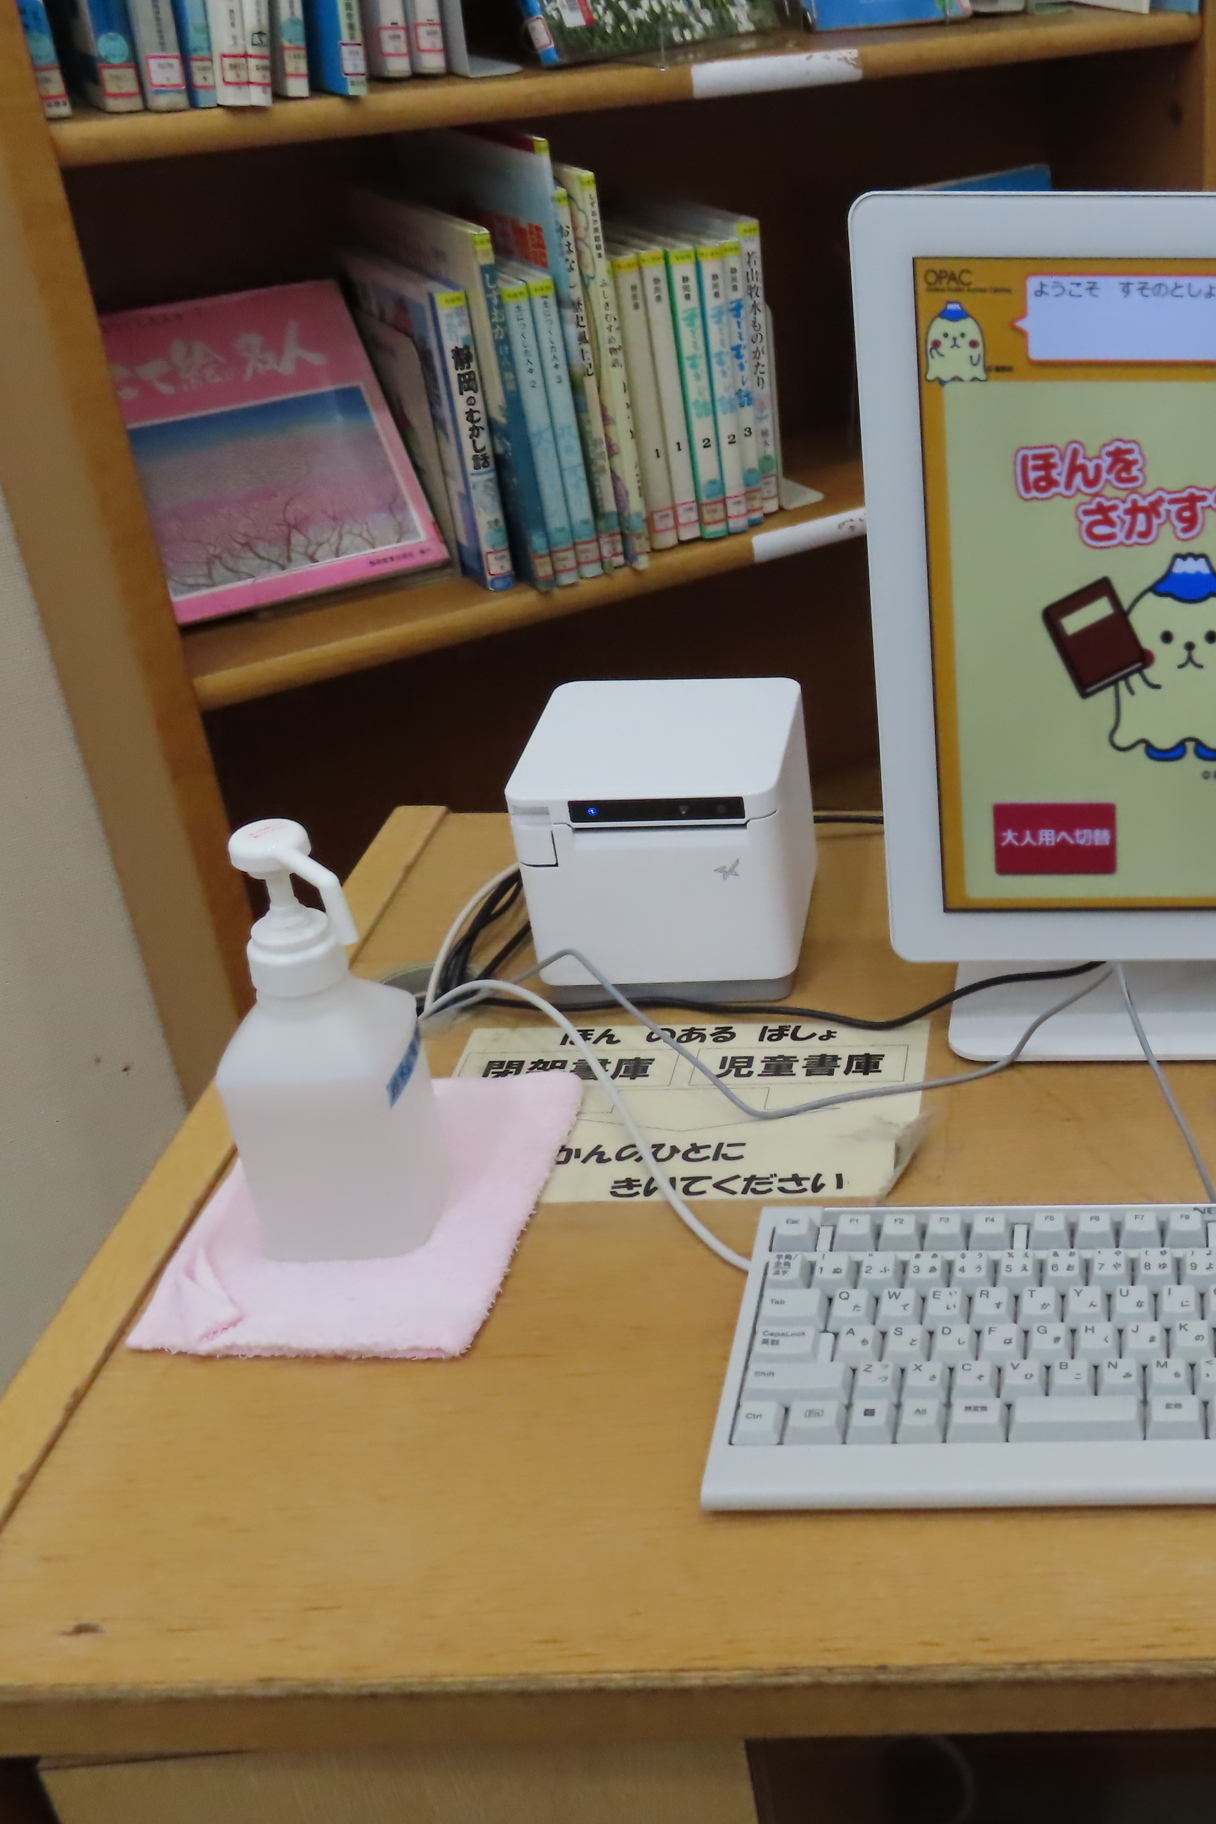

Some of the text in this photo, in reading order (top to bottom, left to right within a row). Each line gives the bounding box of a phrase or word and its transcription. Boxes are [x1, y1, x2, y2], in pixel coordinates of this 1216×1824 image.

[924, 269, 972, 287] OPAC
[1034, 281, 1101, 298] ようこそ
[451, 344, 491, 471] 静岡のむかし話
[743, 427, 753, 437] 3
[702, 438, 712, 448] 2
[727, 434, 737, 445] 2
[675, 442, 682, 451] 1
[655, 449, 661, 459] 1
[1017, 441, 1143, 498] ほんを
[1001, 829, 1111, 846] 大人用へ切替
[646, 1025, 737, 1044] のある
[758, 1025, 838, 1042] ばしょ
[718, 1053, 886, 1078] 児童書庫
[609, 1173, 844, 1198] きいてください
[913, 1265, 920, 1273] 3
[1144, 1262, 1151, 1270] 8
[1190, 1262, 1197, 1270] 9
[839, 1291, 849, 1300] Q
[888, 1291, 901, 1300] W
[933, 1291, 941, 1299] E
[980, 1290, 989, 1298] R
[1029, 1290, 1036, 1298] T
[1074, 1289, 1082, 1297] Y
[1120, 1289, 1129, 1297] U
[894, 1327, 902, 1335] S
[942, 1327, 951, 1335] D
[988, 1327, 996, 1335] F
[1037, 1326, 1047, 1334] G
[1132, 1325, 1139, 1333] J
[1179, 1323, 1188, 1331] K
[863, 1364, 872, 1372] Z
[962, 1363, 971, 1371] C
[1011, 1362, 1019, 1370] V
[1108, 1361, 1117, 1369] N
